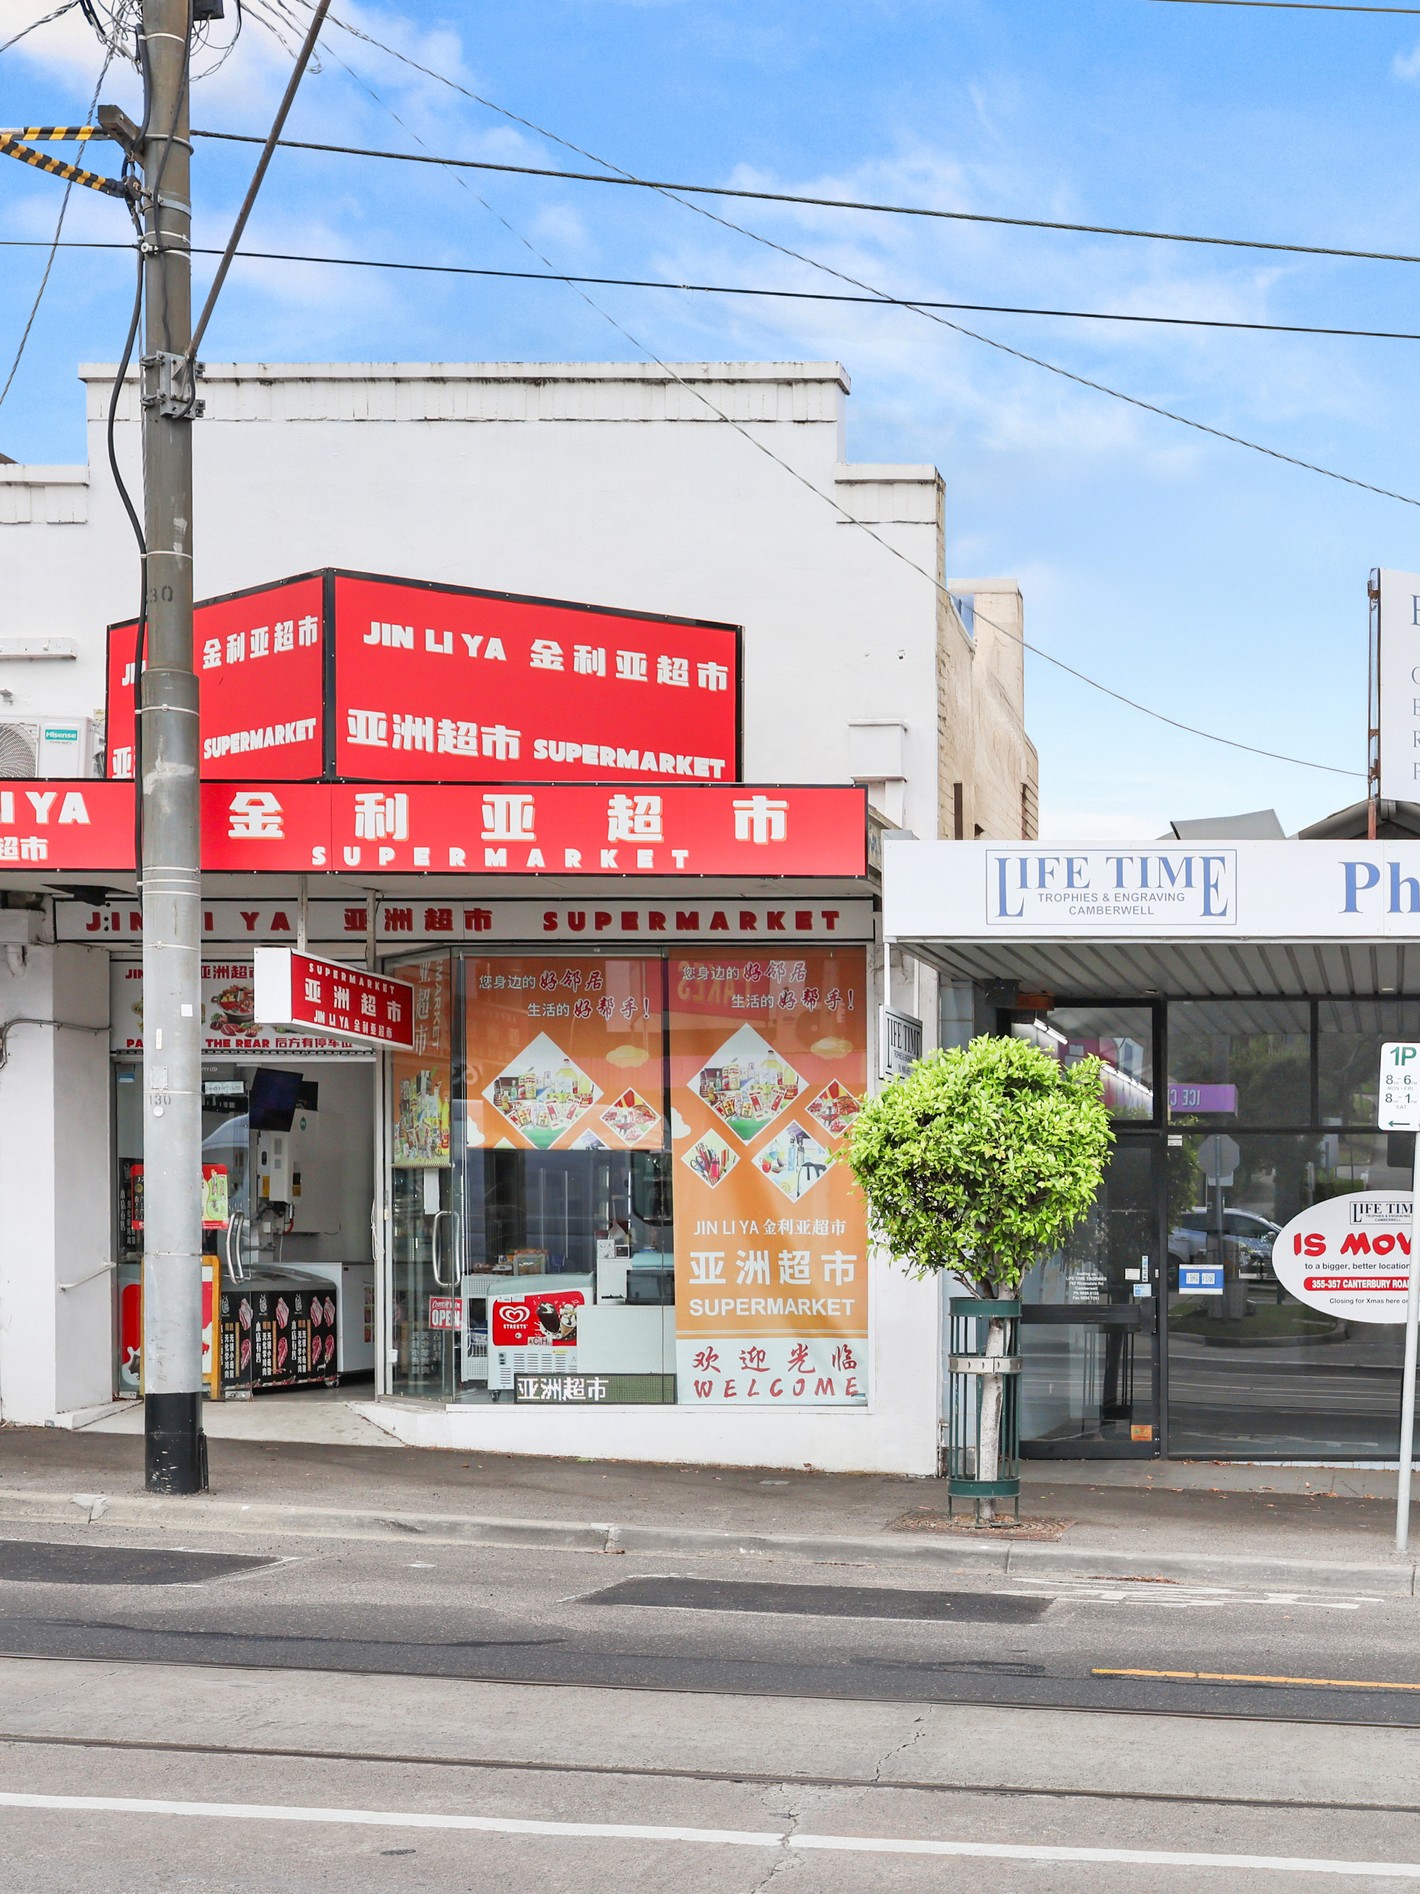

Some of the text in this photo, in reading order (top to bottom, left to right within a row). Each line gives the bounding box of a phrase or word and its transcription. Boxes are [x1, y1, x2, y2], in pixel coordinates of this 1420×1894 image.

[121, 615, 319, 686] JI 金利亚超市
[363, 621, 729, 692] JIN LI YA 金利亚超市
[45, 730, 77, 739] Hisense
[203, 717, 318, 760] SUPERMARKET
[347, 707, 726, 780] 亚洲超市 SUPERMARKET
[25, 791, 92, 825] YA
[227, 790, 789, 845] 金利亚超市
[312, 845, 691, 869] SUPERMARKET
[994, 855, 1229, 918] LIFE TIME
[1038, 892, 1186, 903] TROPHIES & ENGRAVING
[239, 911, 291, 932] YA
[343, 907, 494, 933] 亚洲超市
[543, 910, 842, 933] SUPERMARKET
[1068, 905, 1155, 916] CAMBERWELL
[308, 963, 397, 995] SUPERMARKET
[478, 969, 603, 994] 您身边的好邻居
[305, 978, 402, 1024] 亚洲超市
[313, 1009, 393, 1040] JIN LI YA 金利亚超市
[205, 1038, 231, 1048] THE
[235, 1038, 270, 1048] REAR
[1390, 1046, 1418, 1066] 1P
[1352, 1203, 1413, 1223] LIFE TIM
[694, 1218, 847, 1237] JIN LI YA 金利亚超市
[1293, 1232, 1327, 1257] IS
[688, 1249, 858, 1287] 亚洲超市
[1305, 1262, 1314, 1270] to
[1322, 1262, 1351, 1272] bigger,
[1352, 1262, 1377, 1270] better
[1312, 1279, 1341, 1289] 355-357
[1343, 1279, 1391, 1289] CANTERBURY
[689, 1298, 855, 1317] SUPERMARKET
[1329, 1297, 1353, 1305] Closing
[432, 1309, 461, 1327] OPEN
[692, 1343, 858, 1374] 欢迎光临
[517, 1376, 608, 1401] 亚洲超市
[694, 1377, 859, 1399] WELCOME
